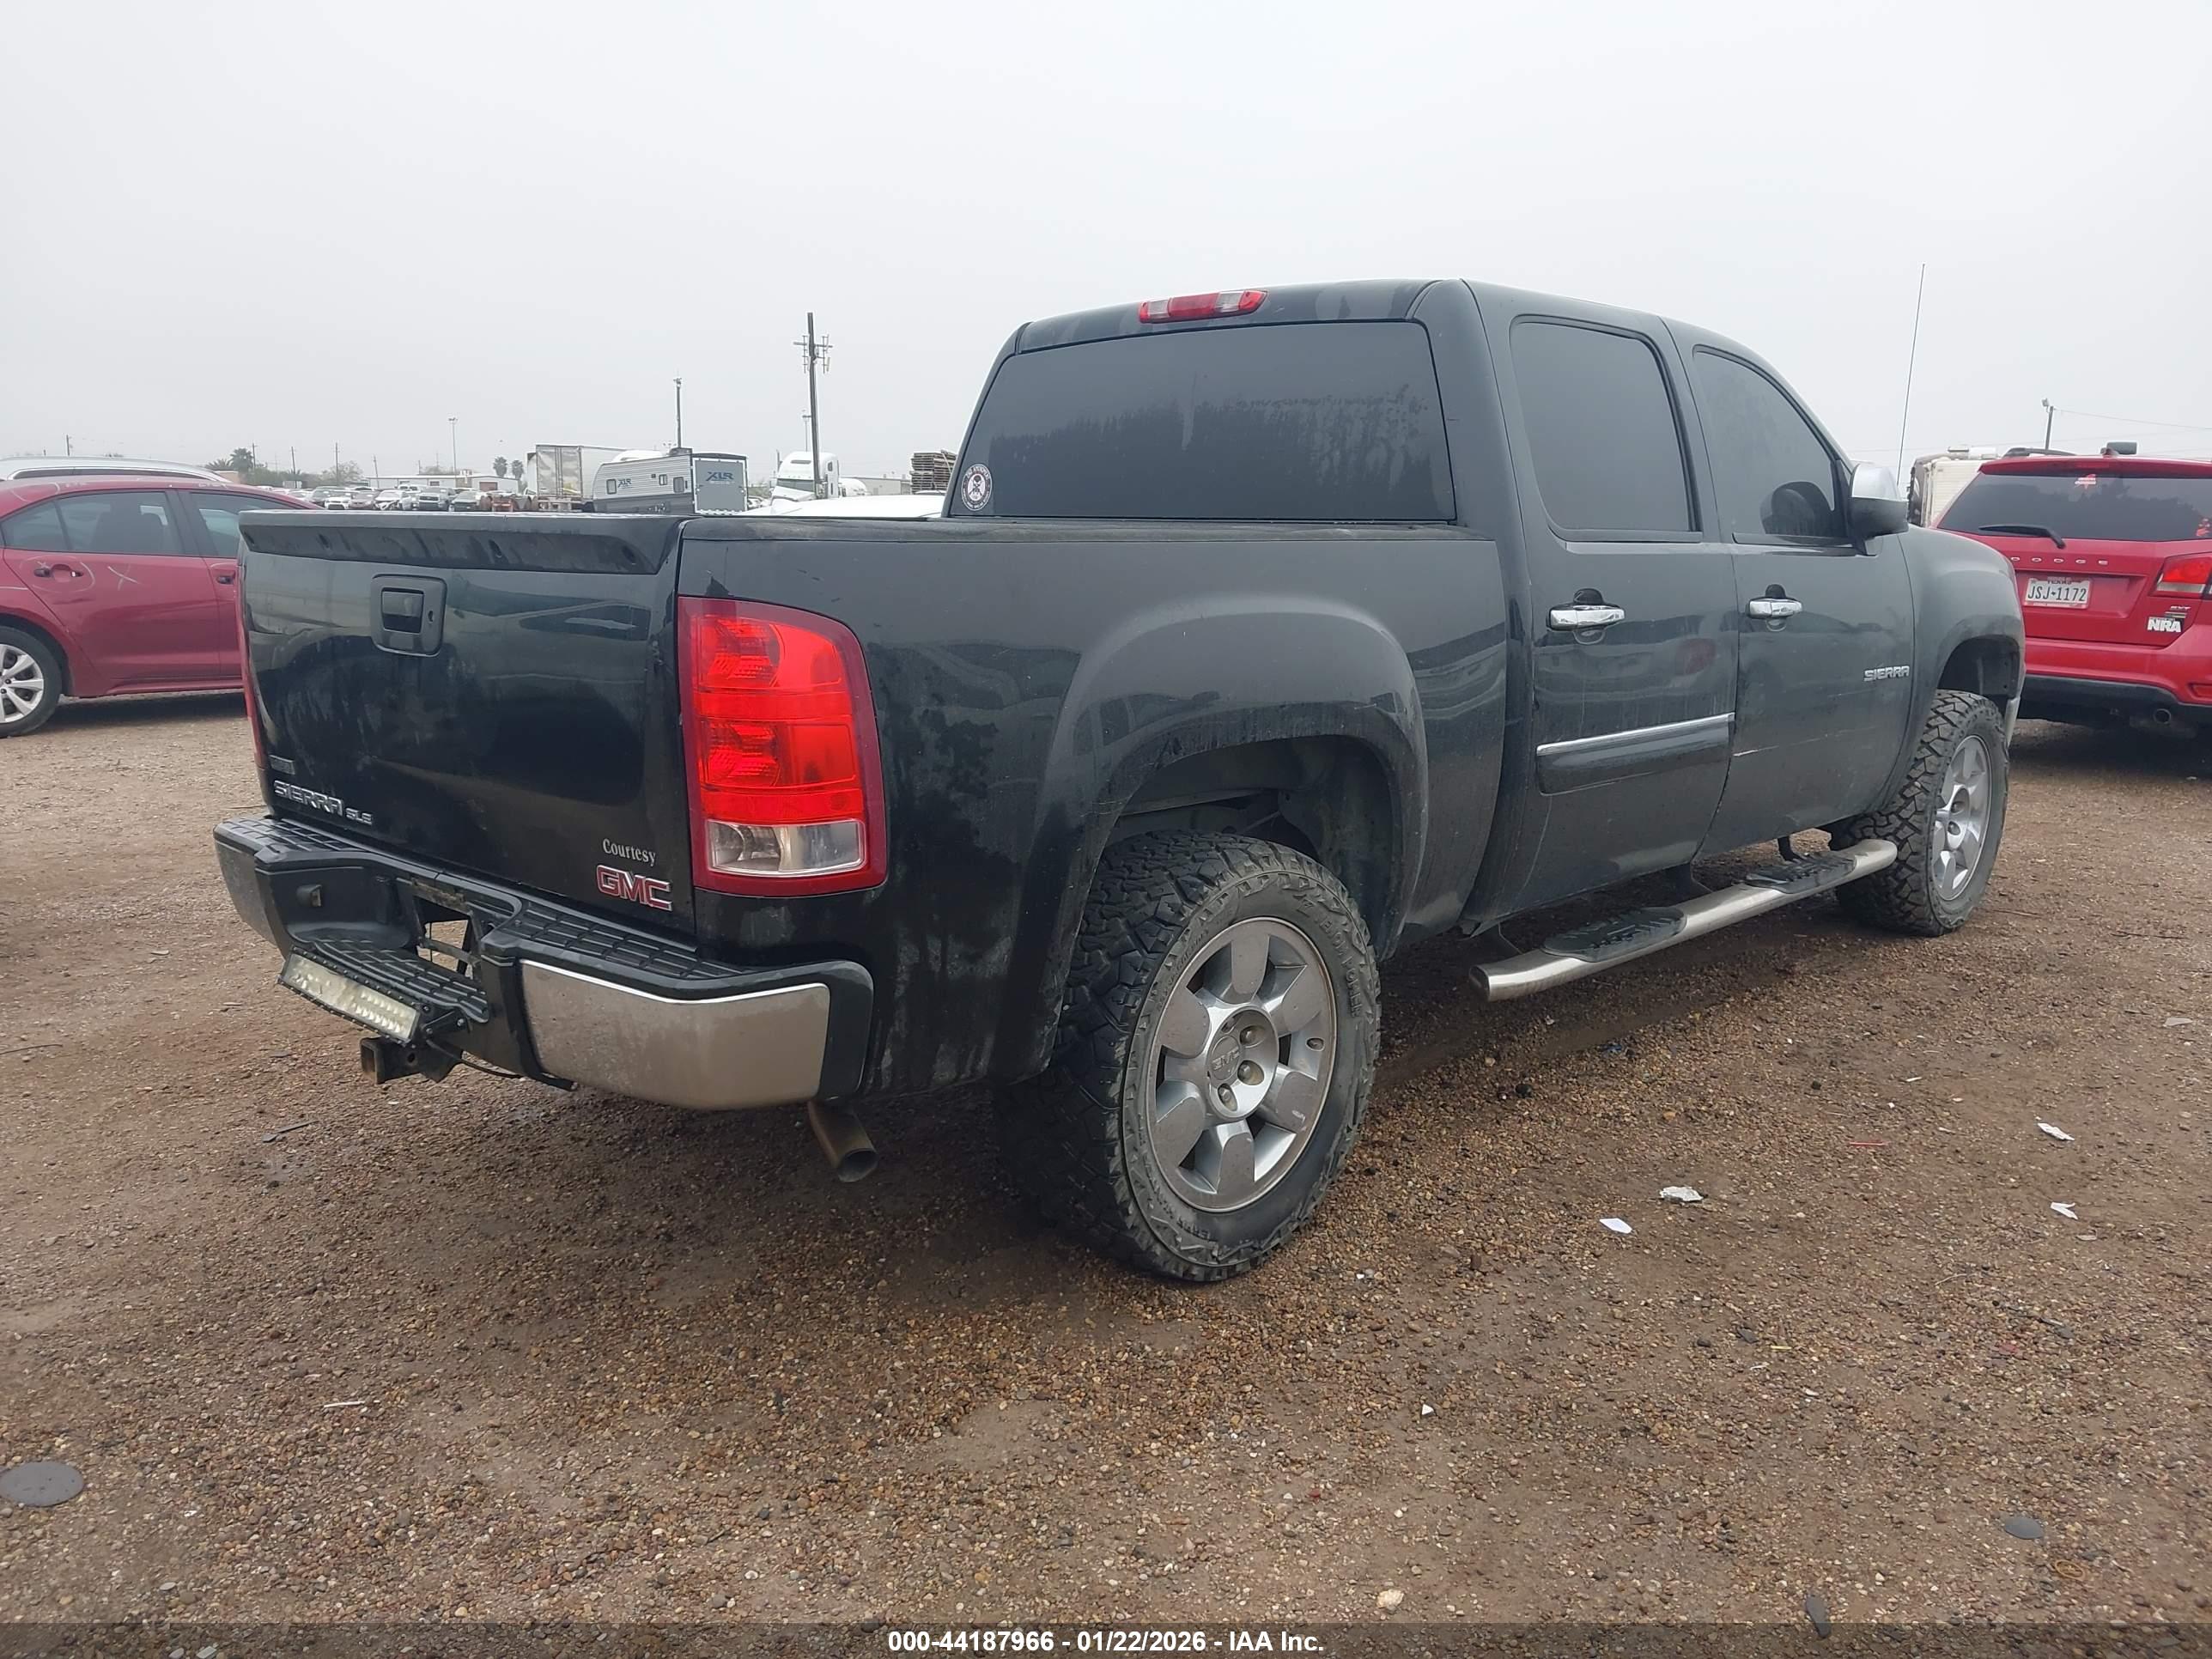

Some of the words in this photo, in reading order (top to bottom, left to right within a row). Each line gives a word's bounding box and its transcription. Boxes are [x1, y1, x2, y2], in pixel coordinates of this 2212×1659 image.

[705, 471, 734, 482] XLR
[2148, 618, 2182, 633] NRA
[1863, 665, 1910, 682] SIERRA
[274, 780, 343, 817] SIERRA
[345, 807, 373, 825] SLE
[603, 838, 656, 867] Courtesy
[596, 864, 672, 912] GMC
